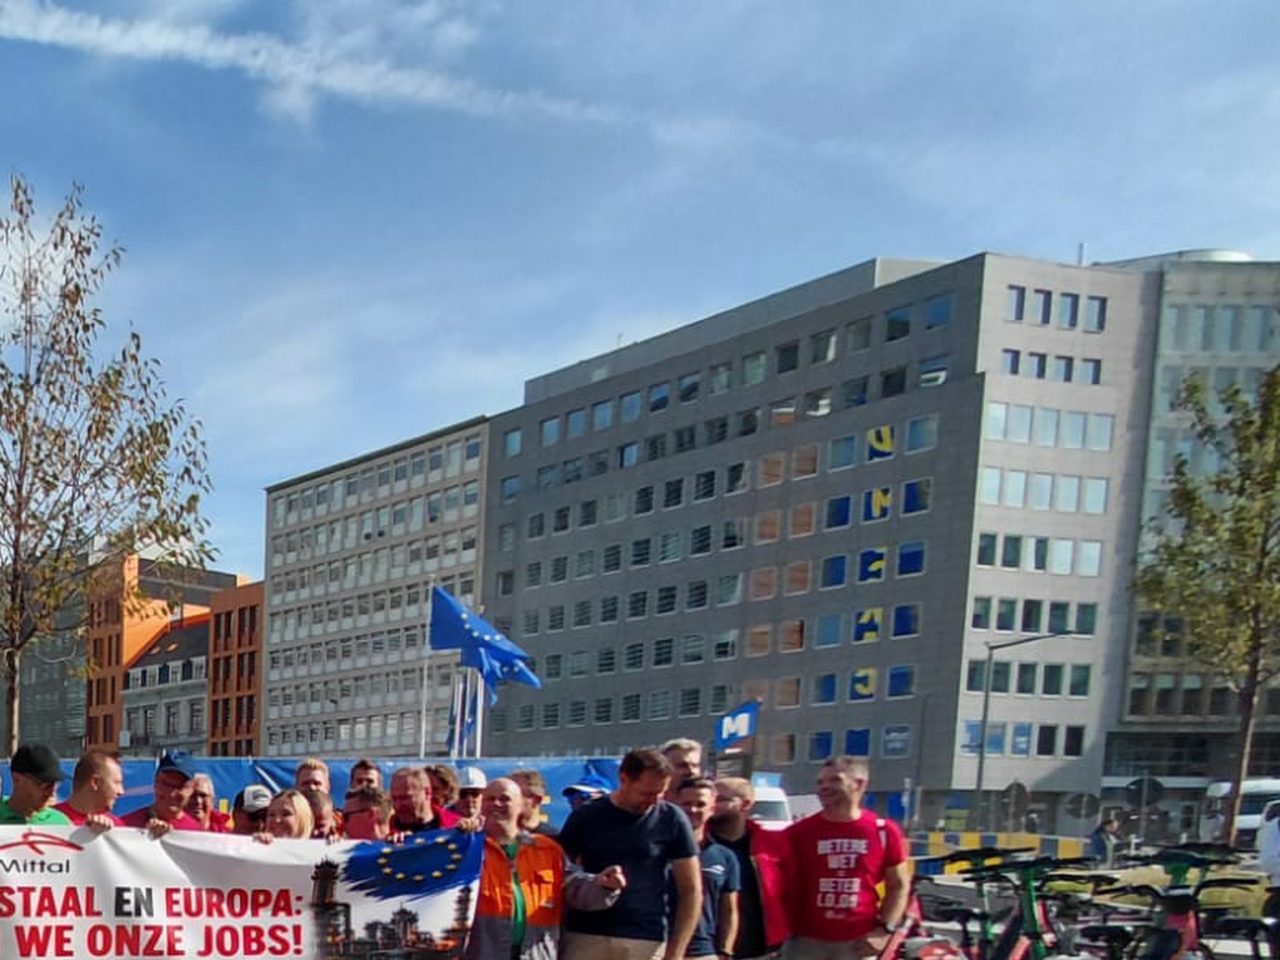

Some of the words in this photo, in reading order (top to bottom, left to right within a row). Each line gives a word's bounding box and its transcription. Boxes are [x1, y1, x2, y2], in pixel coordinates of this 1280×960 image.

[722, 713, 750, 739] M
[114, 886, 154, 918] EN
[165, 887, 304, 918] EUROPA:
[14, 925, 74, 958] WE
[86, 924, 185, 957] ONZE
[197, 924, 304, 957] JOBS!
